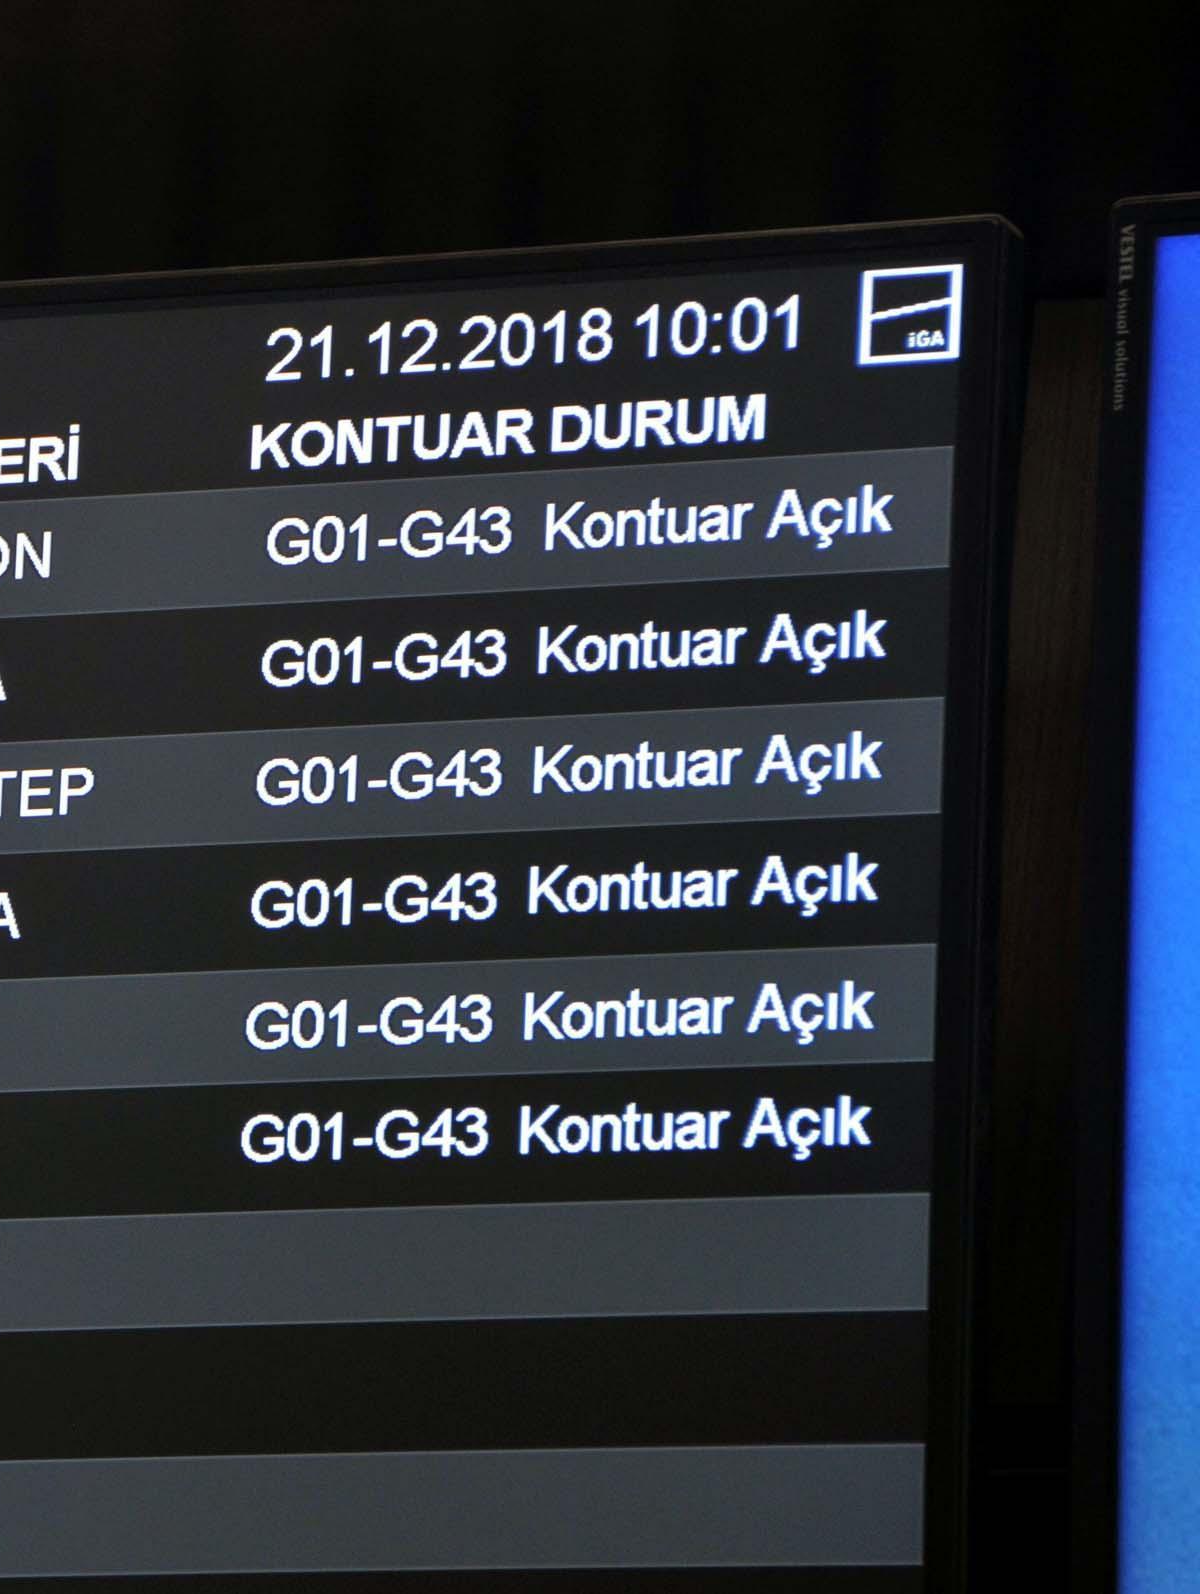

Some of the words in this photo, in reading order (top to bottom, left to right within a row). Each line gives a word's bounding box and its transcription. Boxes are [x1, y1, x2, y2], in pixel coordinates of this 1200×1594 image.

[265, 307, 613, 382] 21.12.2018
[635, 294, 799, 358] 10:01
[250, 408, 536, 470] KONTUAR
[550, 393, 767, 453] DURUM
[266, 505, 513, 566] G01-G43
[544, 497, 755, 551] Kontuar
[765, 484, 894, 549] Açık
[261, 628, 507, 688] G01-G43
[537, 620, 748, 675] Kontuar
[759, 609, 887, 674] Açık
[256, 748, 503, 806] G01-G43
[533, 740, 743, 794] Kontuar
[754, 730, 883, 795] Açık
[250, 871, 498, 929] G01-G43
[528, 861, 739, 914] Kontuar
[750, 852, 879, 917] Açık
[245, 993, 493, 1050] G01-G43
[523, 988, 735, 1041] Kontuar
[746, 979, 875, 1045] Açık
[240, 1106, 489, 1163] G01-G43
[519, 1102, 731, 1155] Kontuar
[742, 1095, 872, 1161] Açık
